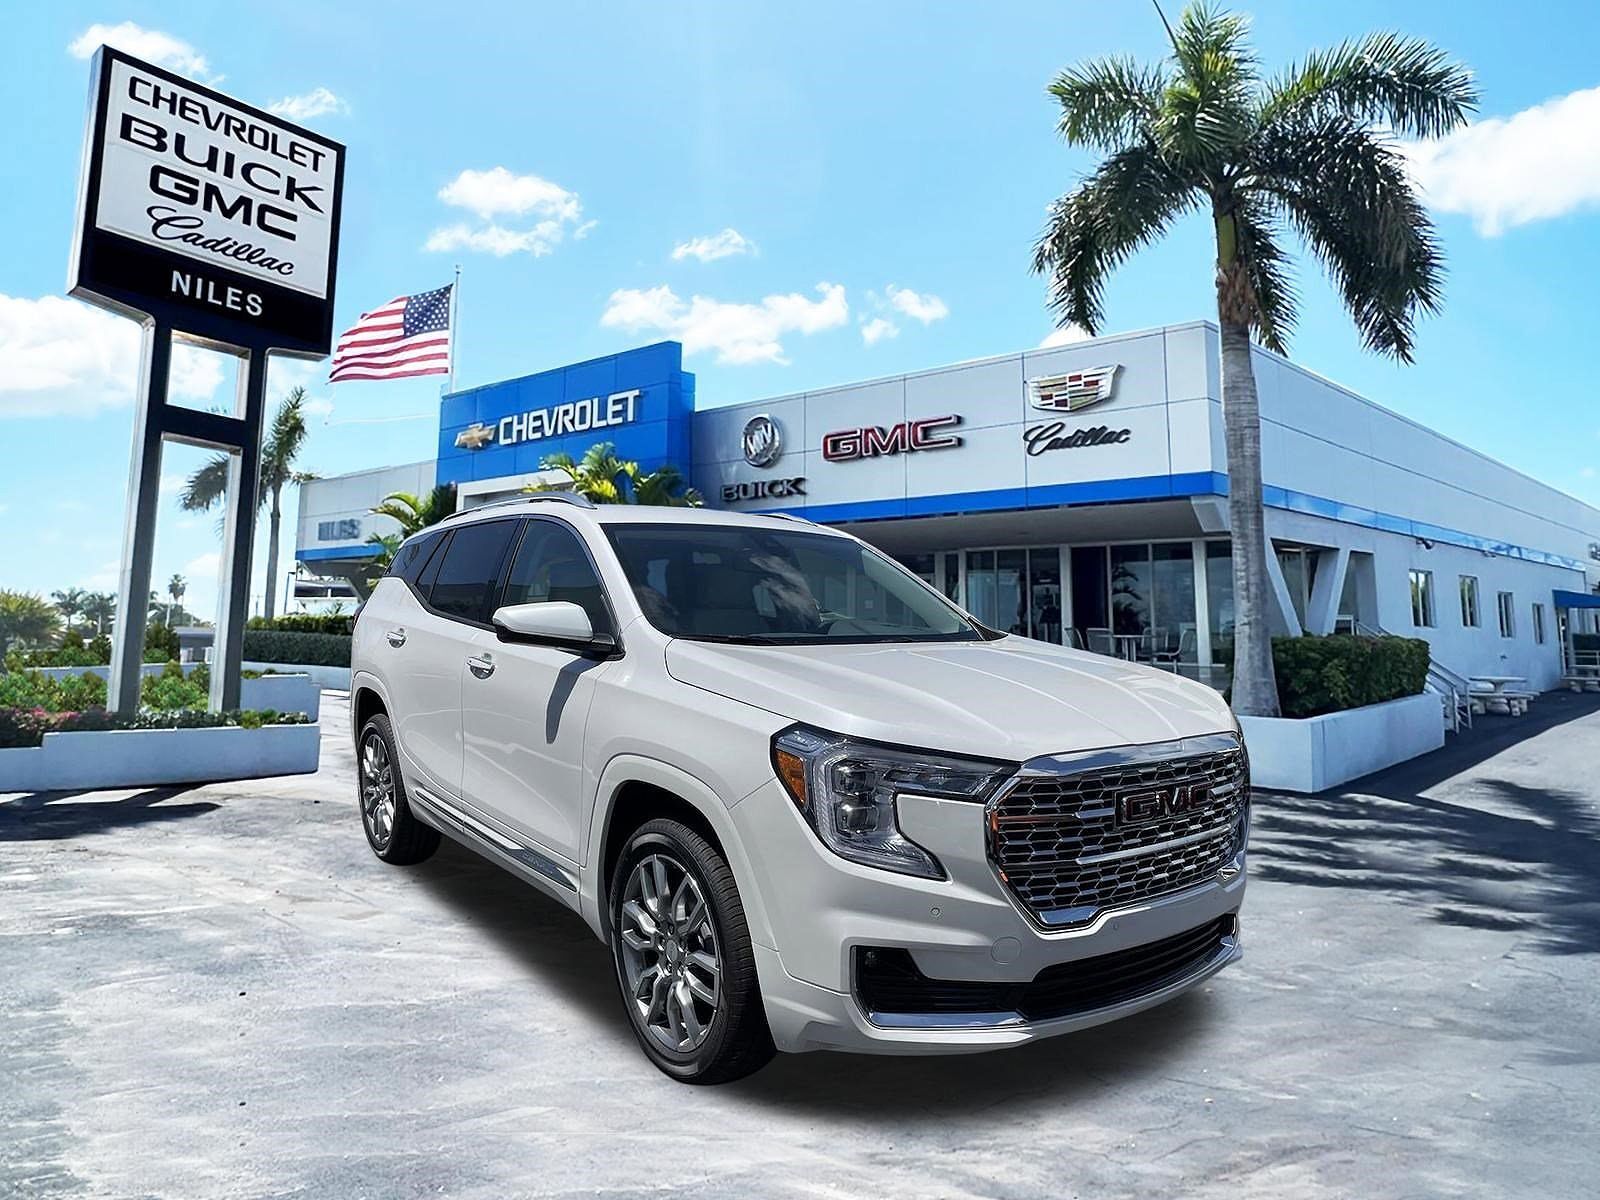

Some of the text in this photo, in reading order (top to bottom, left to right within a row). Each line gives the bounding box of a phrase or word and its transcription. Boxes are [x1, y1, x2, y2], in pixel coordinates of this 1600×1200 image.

[129, 76, 326, 172] CHEVROLET
[119, 112, 325, 214] BUICK
[149, 164, 298, 242] GMC
[146, 205, 294, 276] Cadillac
[171, 270, 263, 317] NILES
[498, 389, 640, 446] CHEVROLET
[822, 414, 962, 462] GMC
[1022, 421, 1132, 457] Cadillac
[720, 477, 807, 502] BUICK
[1122, 781, 1214, 823] GMC
